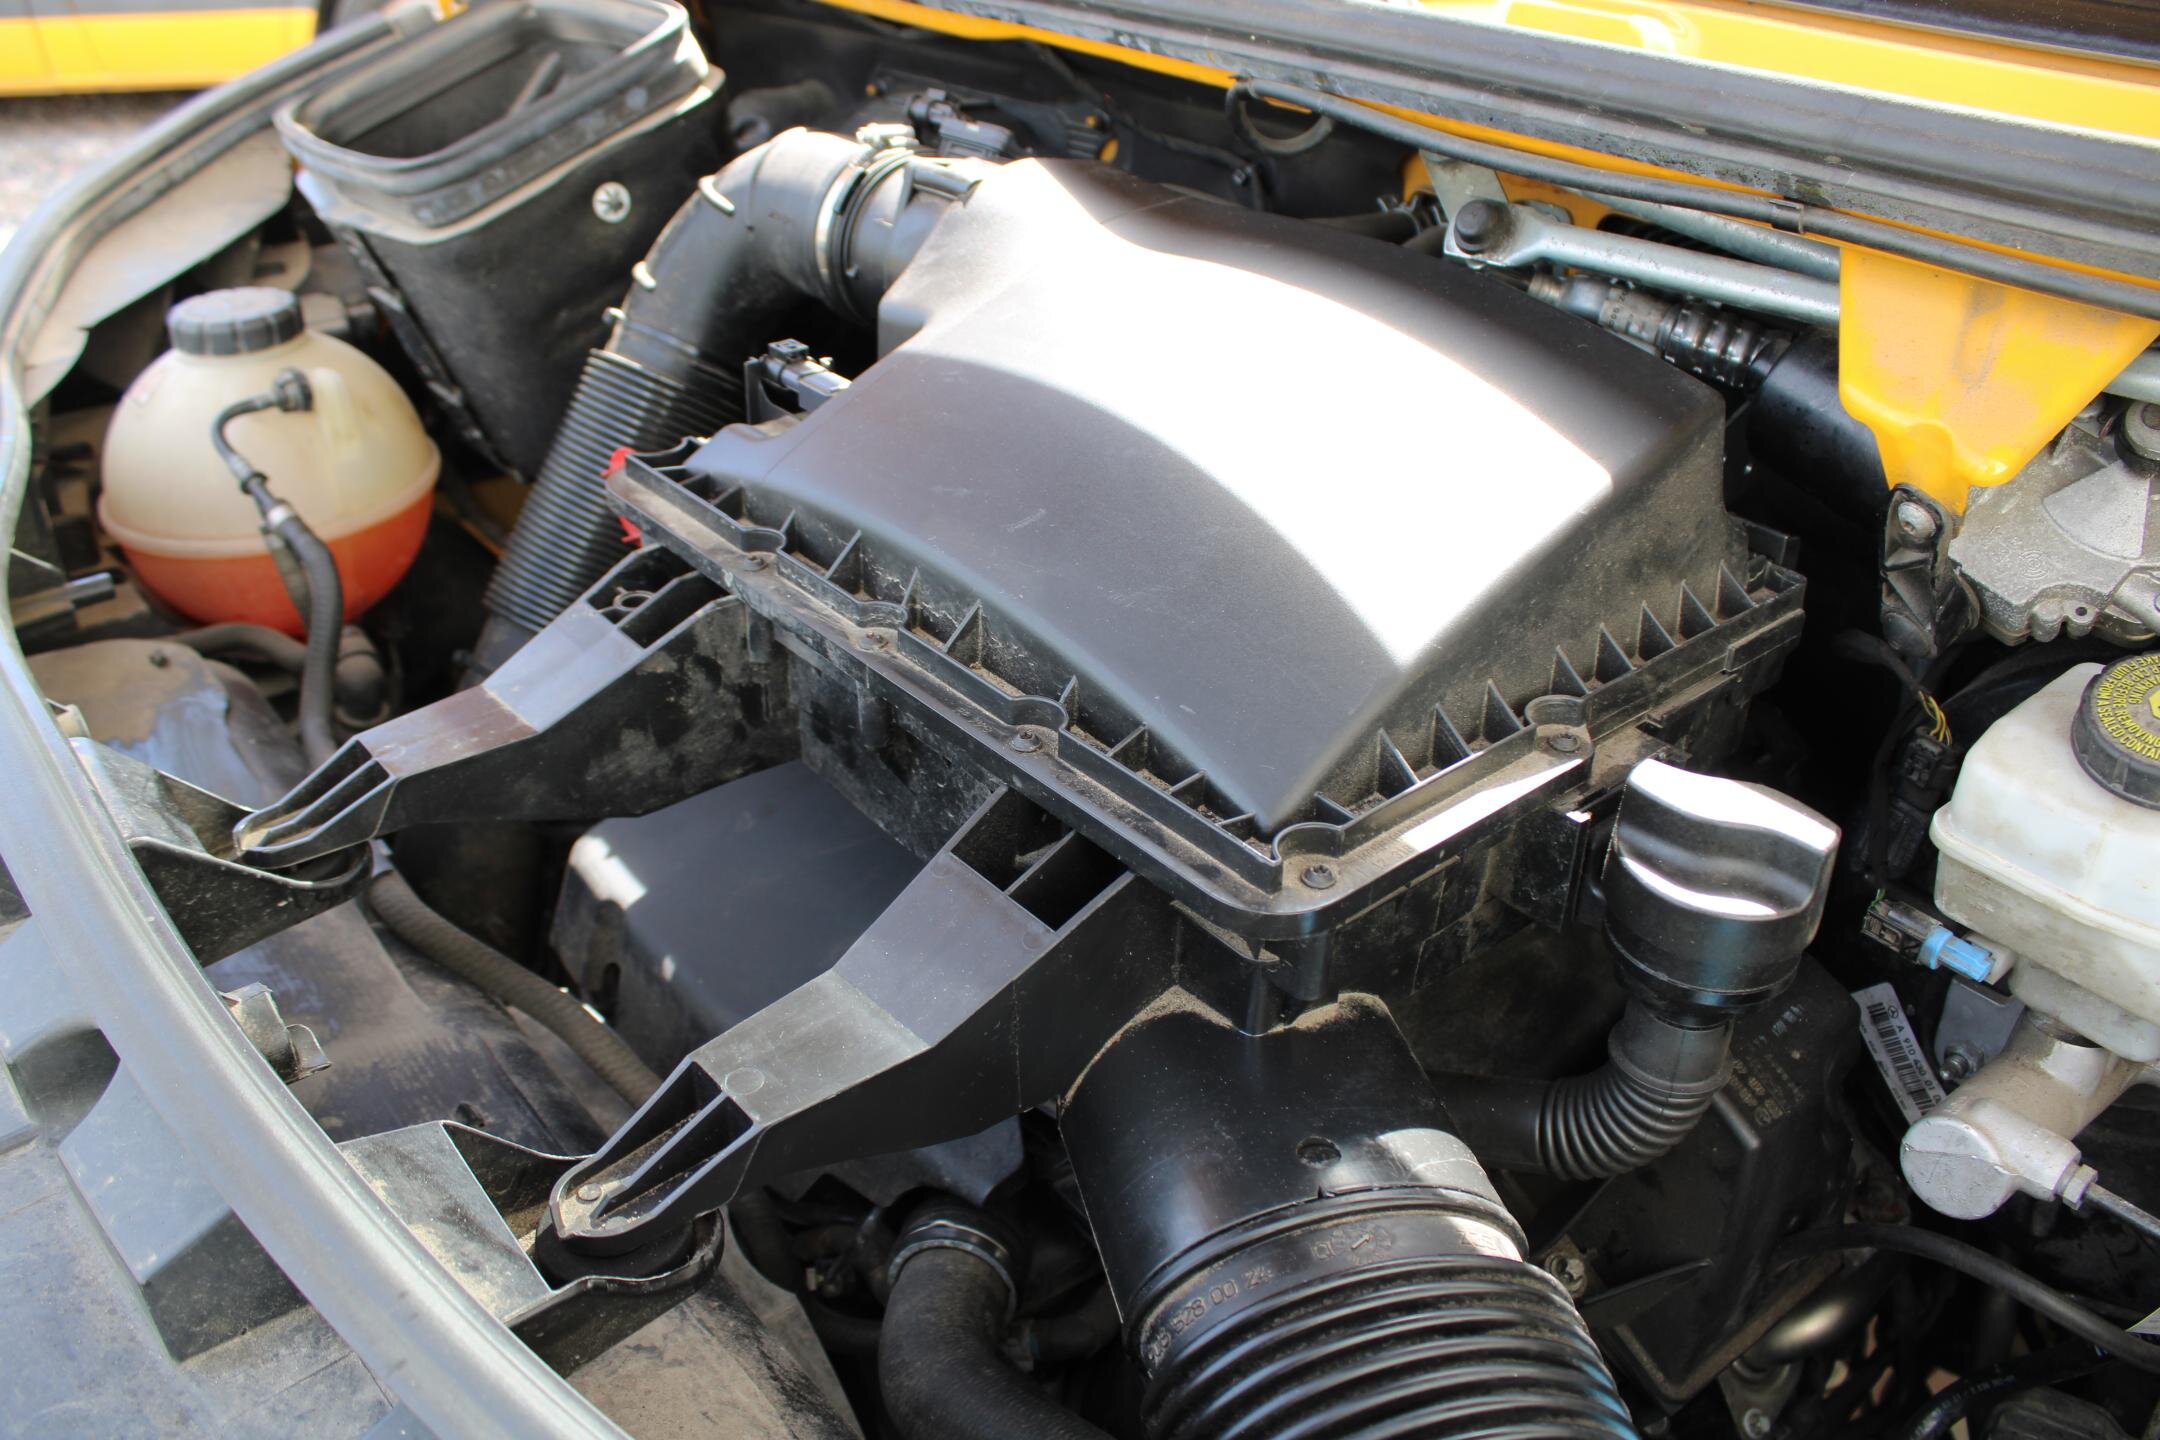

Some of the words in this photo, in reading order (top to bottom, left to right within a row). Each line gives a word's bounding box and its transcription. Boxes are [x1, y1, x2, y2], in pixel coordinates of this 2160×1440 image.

[2111, 661, 2138, 680] FLUID
[2131, 667, 2150, 682] CAP
[2097, 678, 2117, 699] FROM
[2113, 678, 2134, 708] BEFORE
[2128, 674, 2160, 704] ARNING
[2097, 708, 2125, 738] SEALED
[2114, 709, 2160, 747] REMOVING
[1903, 1037, 1916, 1055] 910
[1170, 1297, 1206, 1335] 528
[1209, 1279, 1239, 1305] 00
